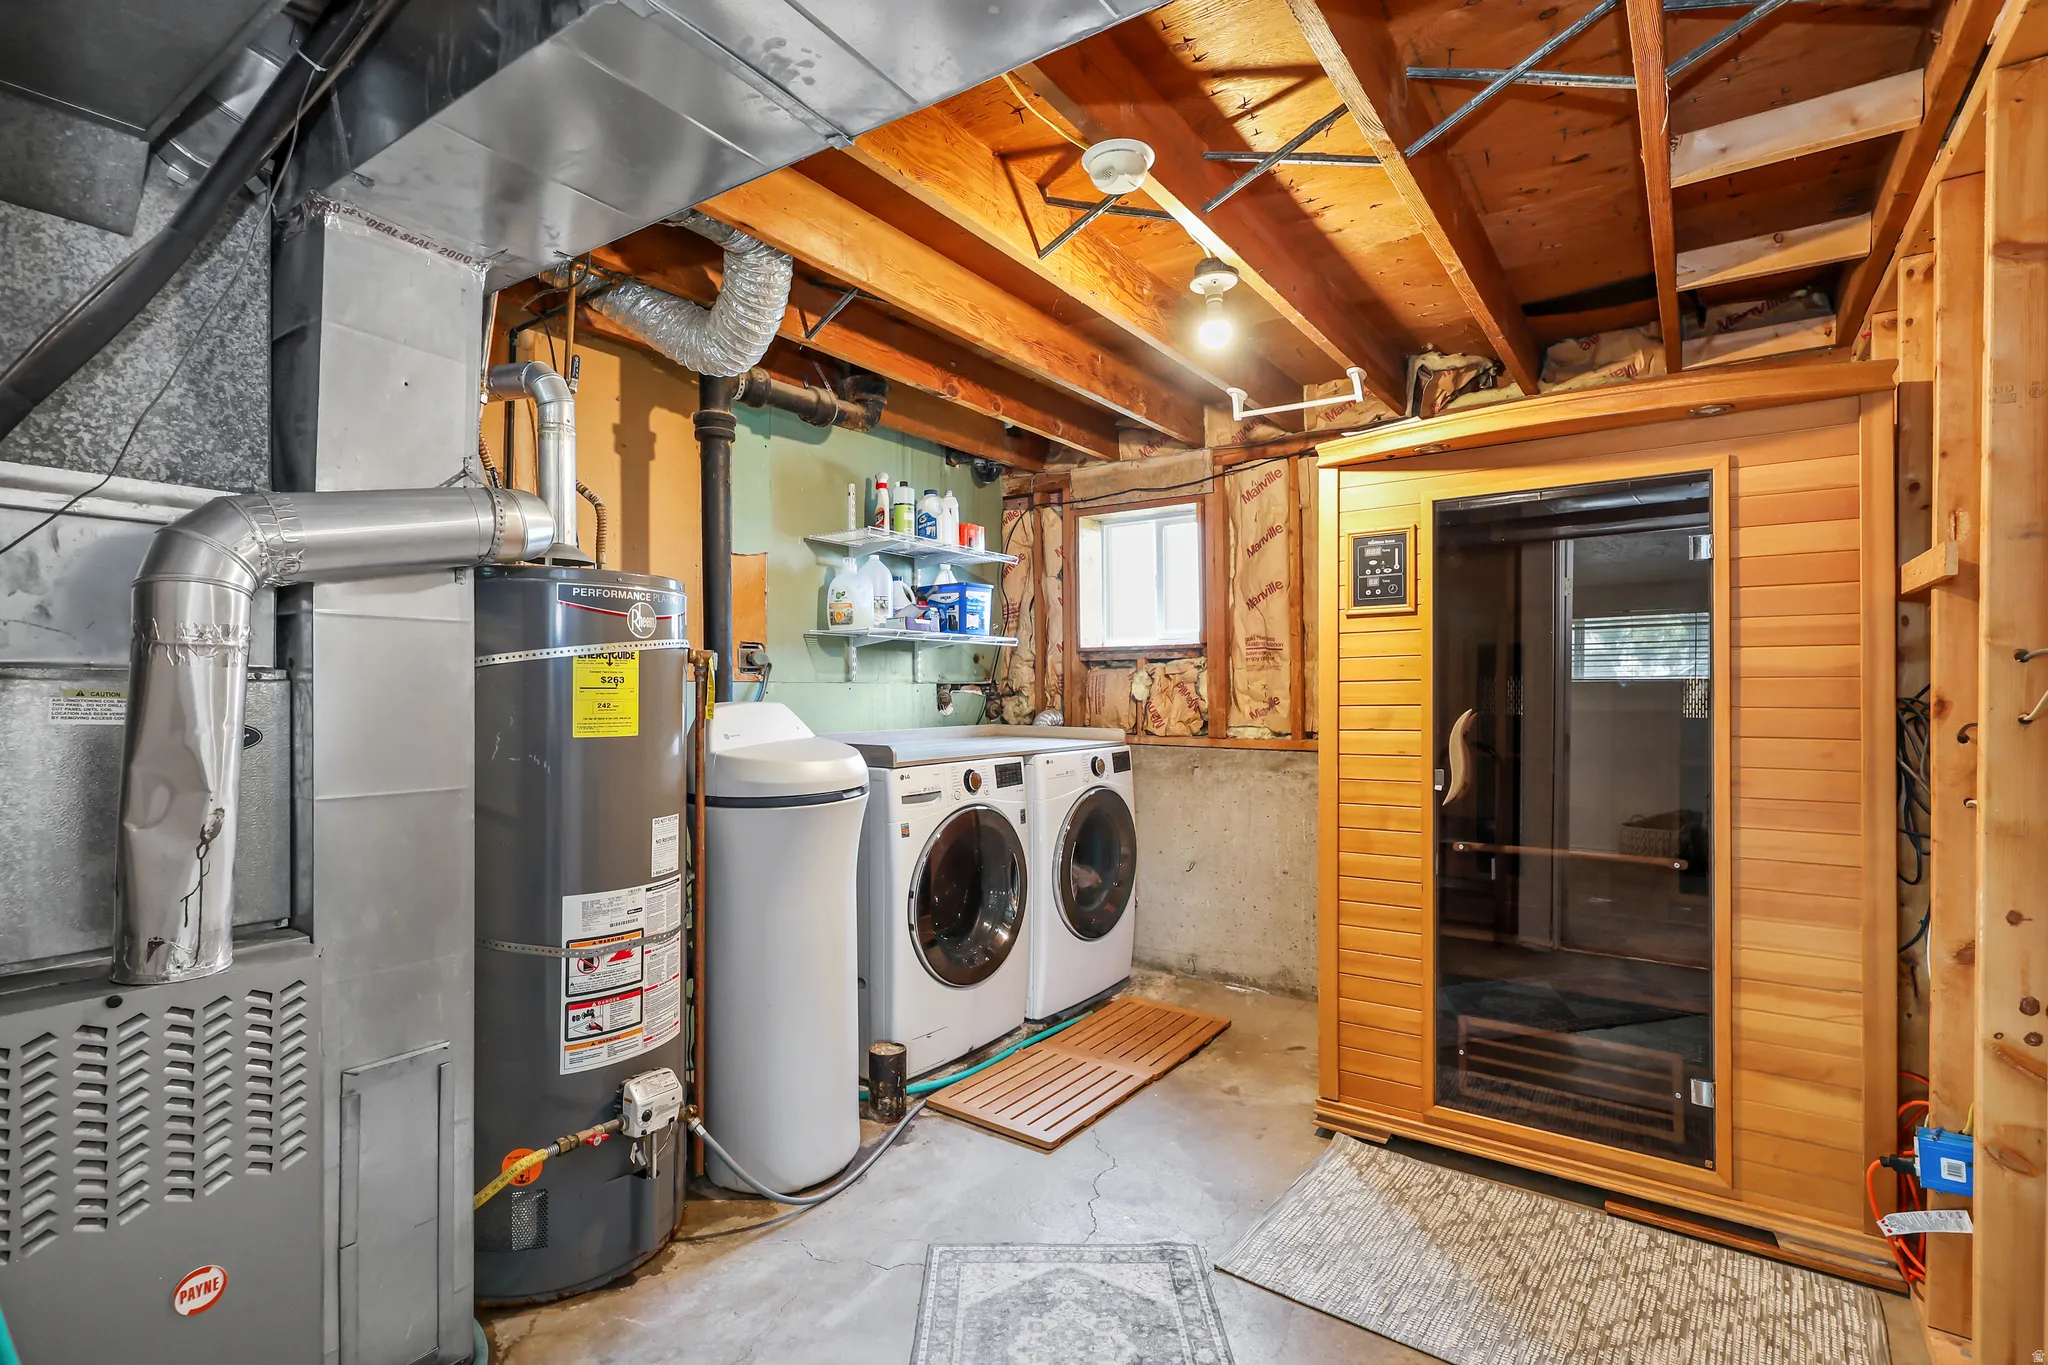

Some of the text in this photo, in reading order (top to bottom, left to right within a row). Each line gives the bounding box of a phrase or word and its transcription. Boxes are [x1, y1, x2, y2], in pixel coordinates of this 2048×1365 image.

[365, 217, 399, 238] DEAL
[438, 247, 473, 264] 2000
[1241, 468, 1283, 504] Manville
[1246, 524, 1284, 558] Manville
[572, 587, 652, 602] PERFORMANCE
[1246, 581, 1284, 611] Manville
[631, 602, 656, 633] Rheem
[600, 676, 625, 684] $263
[598, 936, 625, 945] WARNING
[597, 997, 621, 1006] DANGER
[597, 1035, 621, 1045] WARNING
[179, 1276, 220, 1305] PAYNE
